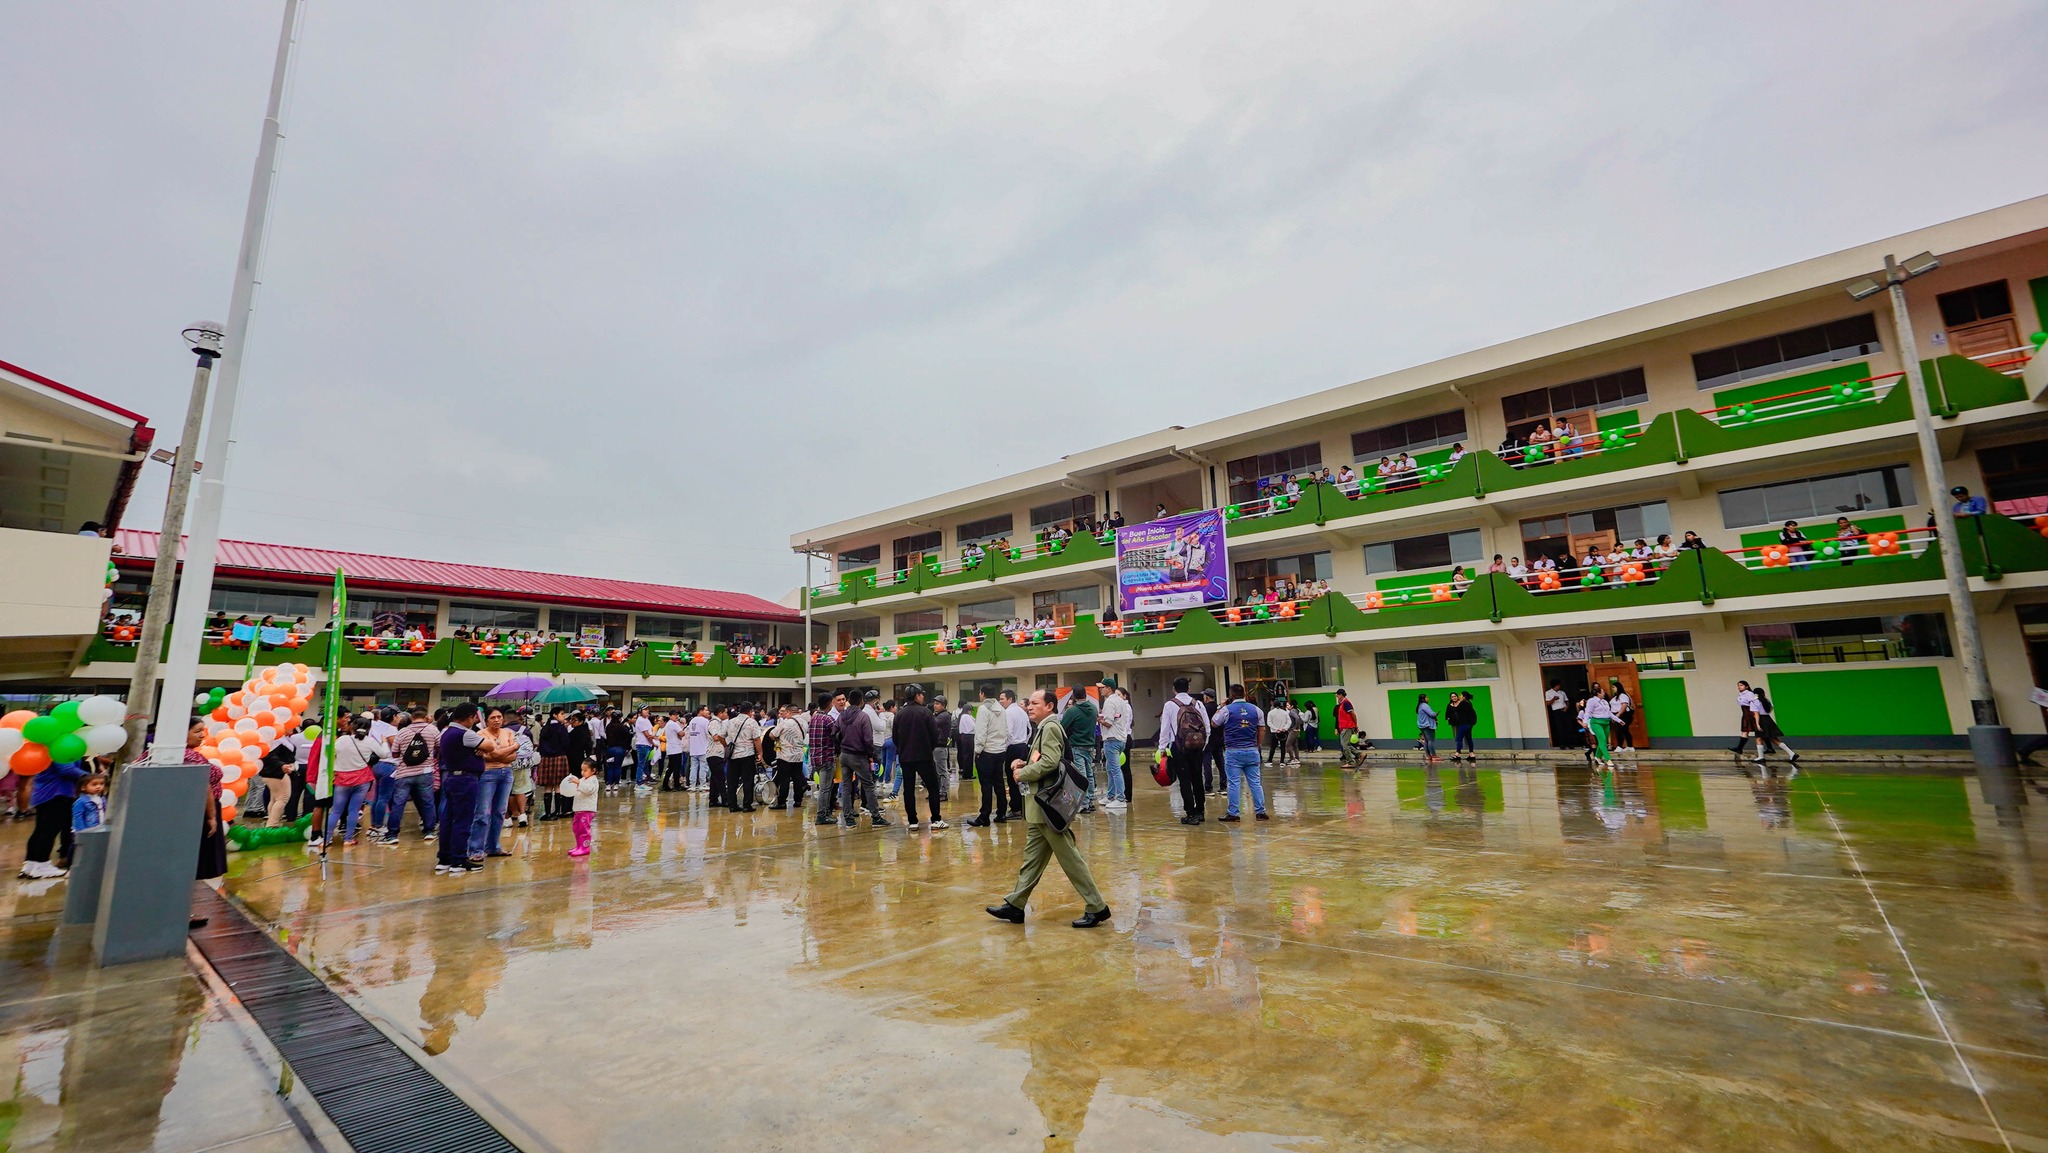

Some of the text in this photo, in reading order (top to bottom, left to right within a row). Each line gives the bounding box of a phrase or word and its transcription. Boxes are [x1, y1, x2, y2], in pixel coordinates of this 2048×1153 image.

[1129, 527, 1165, 538] Buen Inicio
[1147, 533, 1171, 542] Escolar
